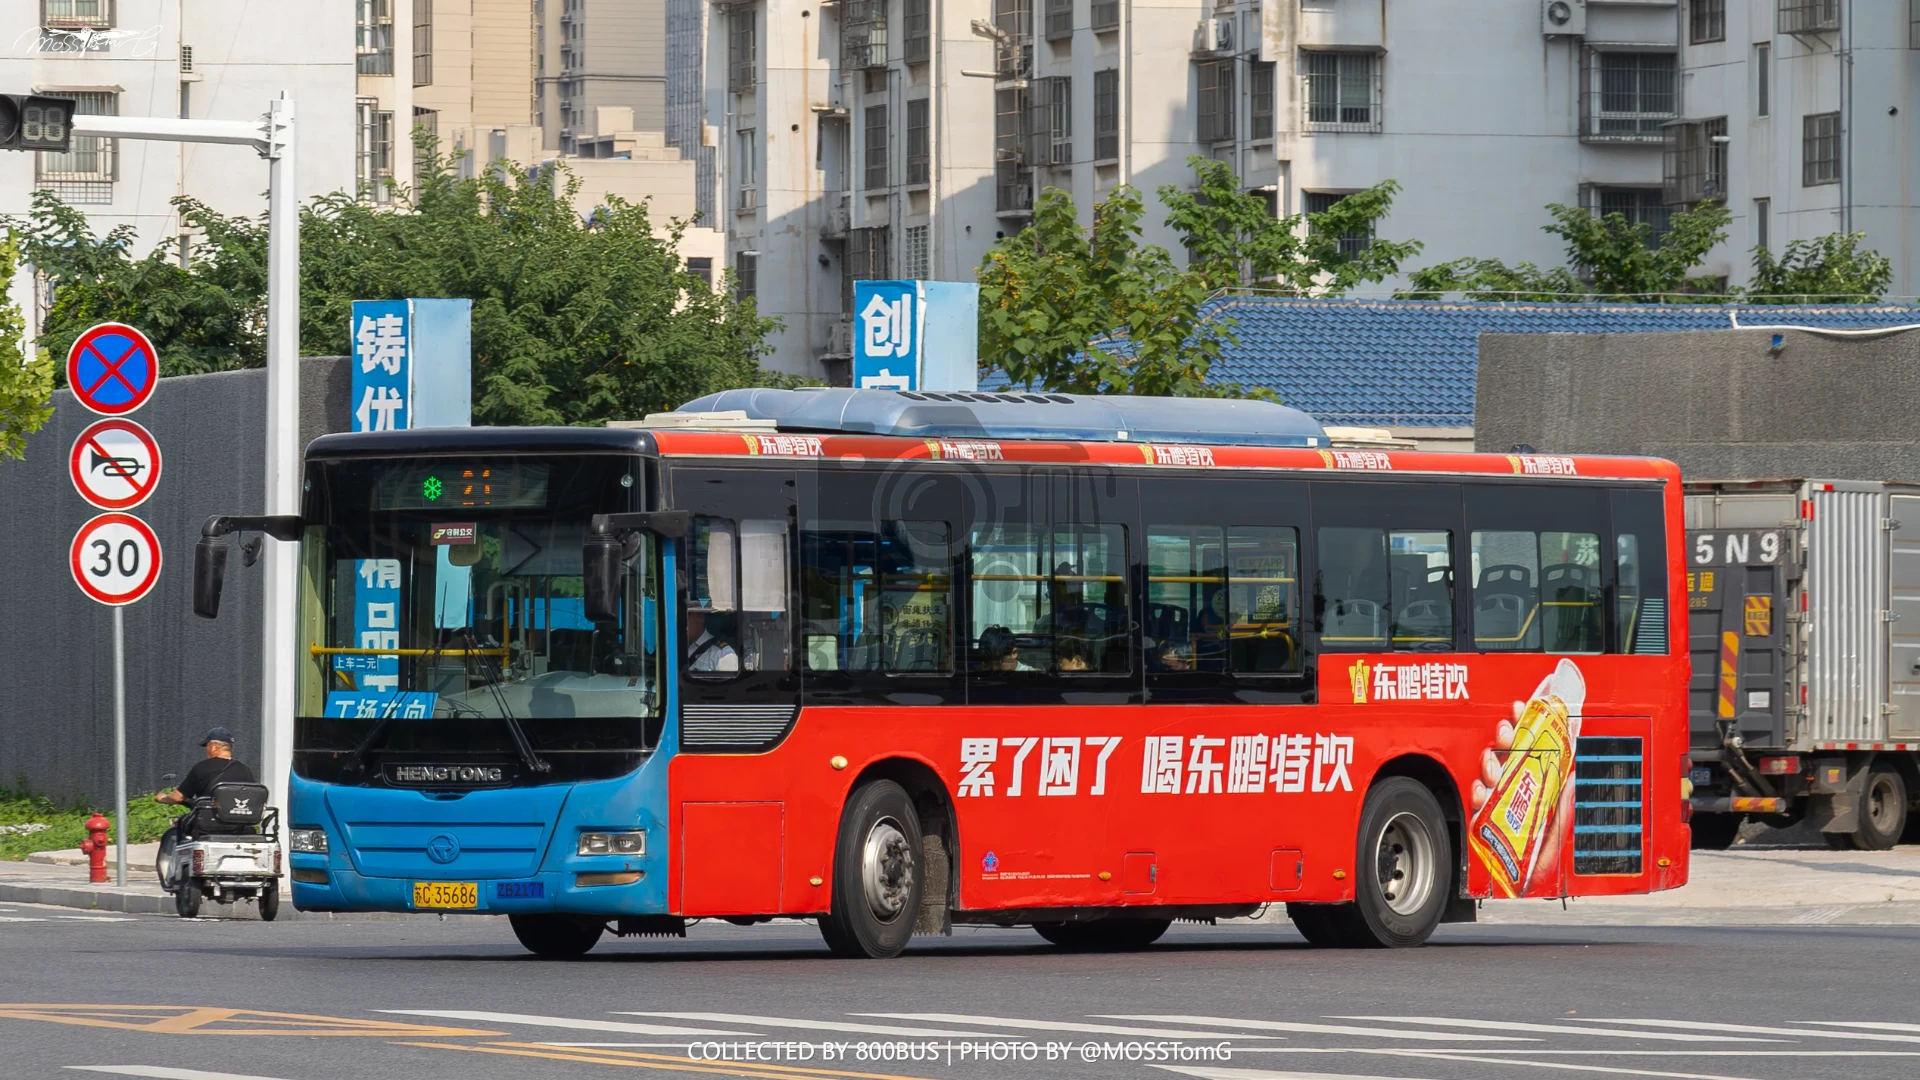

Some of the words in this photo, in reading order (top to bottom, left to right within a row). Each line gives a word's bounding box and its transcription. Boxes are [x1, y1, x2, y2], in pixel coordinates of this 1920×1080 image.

[90, 539, 140, 577] 30
[335, 657, 377, 670] 上车二元
[1373, 662, 1470, 700] 东鹏特饮
[396, 766, 501, 782] HENGTONG
[957, 736, 1123, 798] 累了困了
[1141, 732, 1354, 795] 喝东鹏特饮
[497, 882, 544, 897] ZB2177
